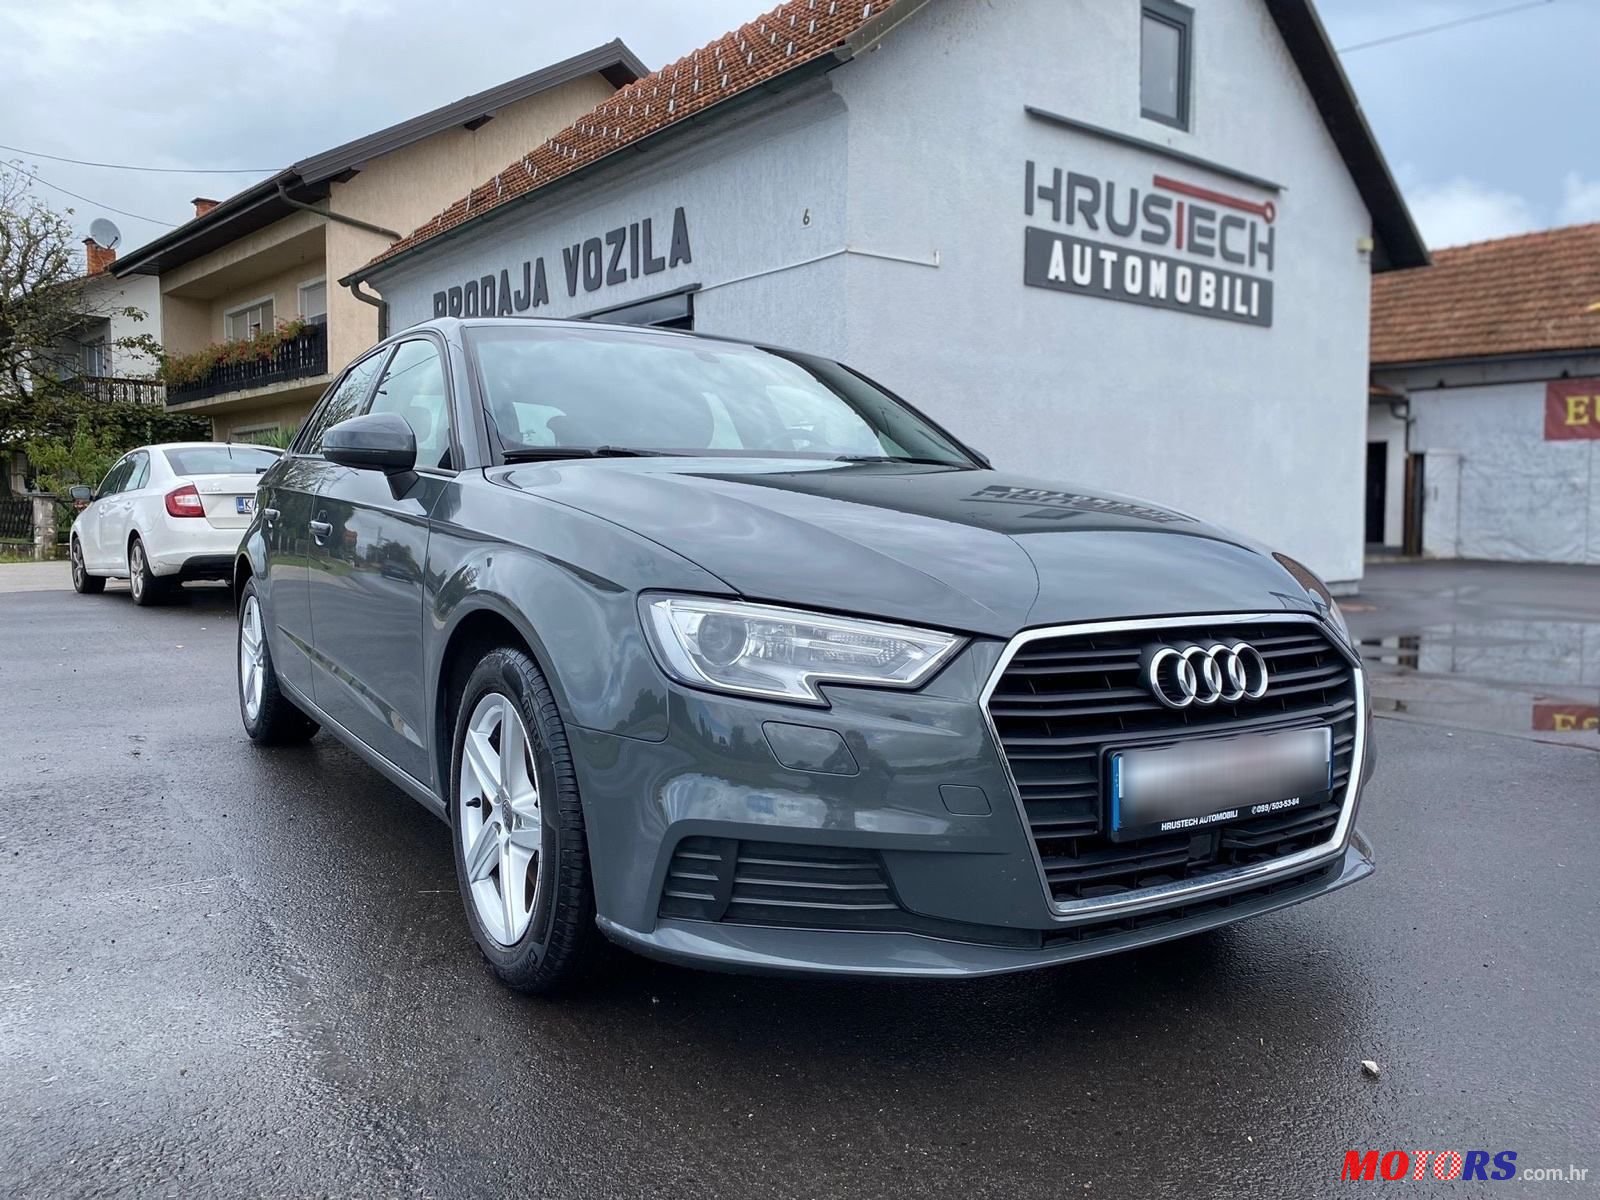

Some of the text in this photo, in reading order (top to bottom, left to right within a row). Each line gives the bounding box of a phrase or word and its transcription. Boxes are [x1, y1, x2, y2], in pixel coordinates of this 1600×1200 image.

[803, 208, 810, 226] 6
[1024, 160, 1275, 272] HRUSTECH
[433, 206, 692, 318] PRODAJA VOZILA
[1048, 240, 1259, 316] AUTOMOBILI
[1565, 395, 1600, 426] E
[1161, 817, 1198, 831] HRUSTECH
[1199, 809, 1239, 825] AUTOMOBILI
